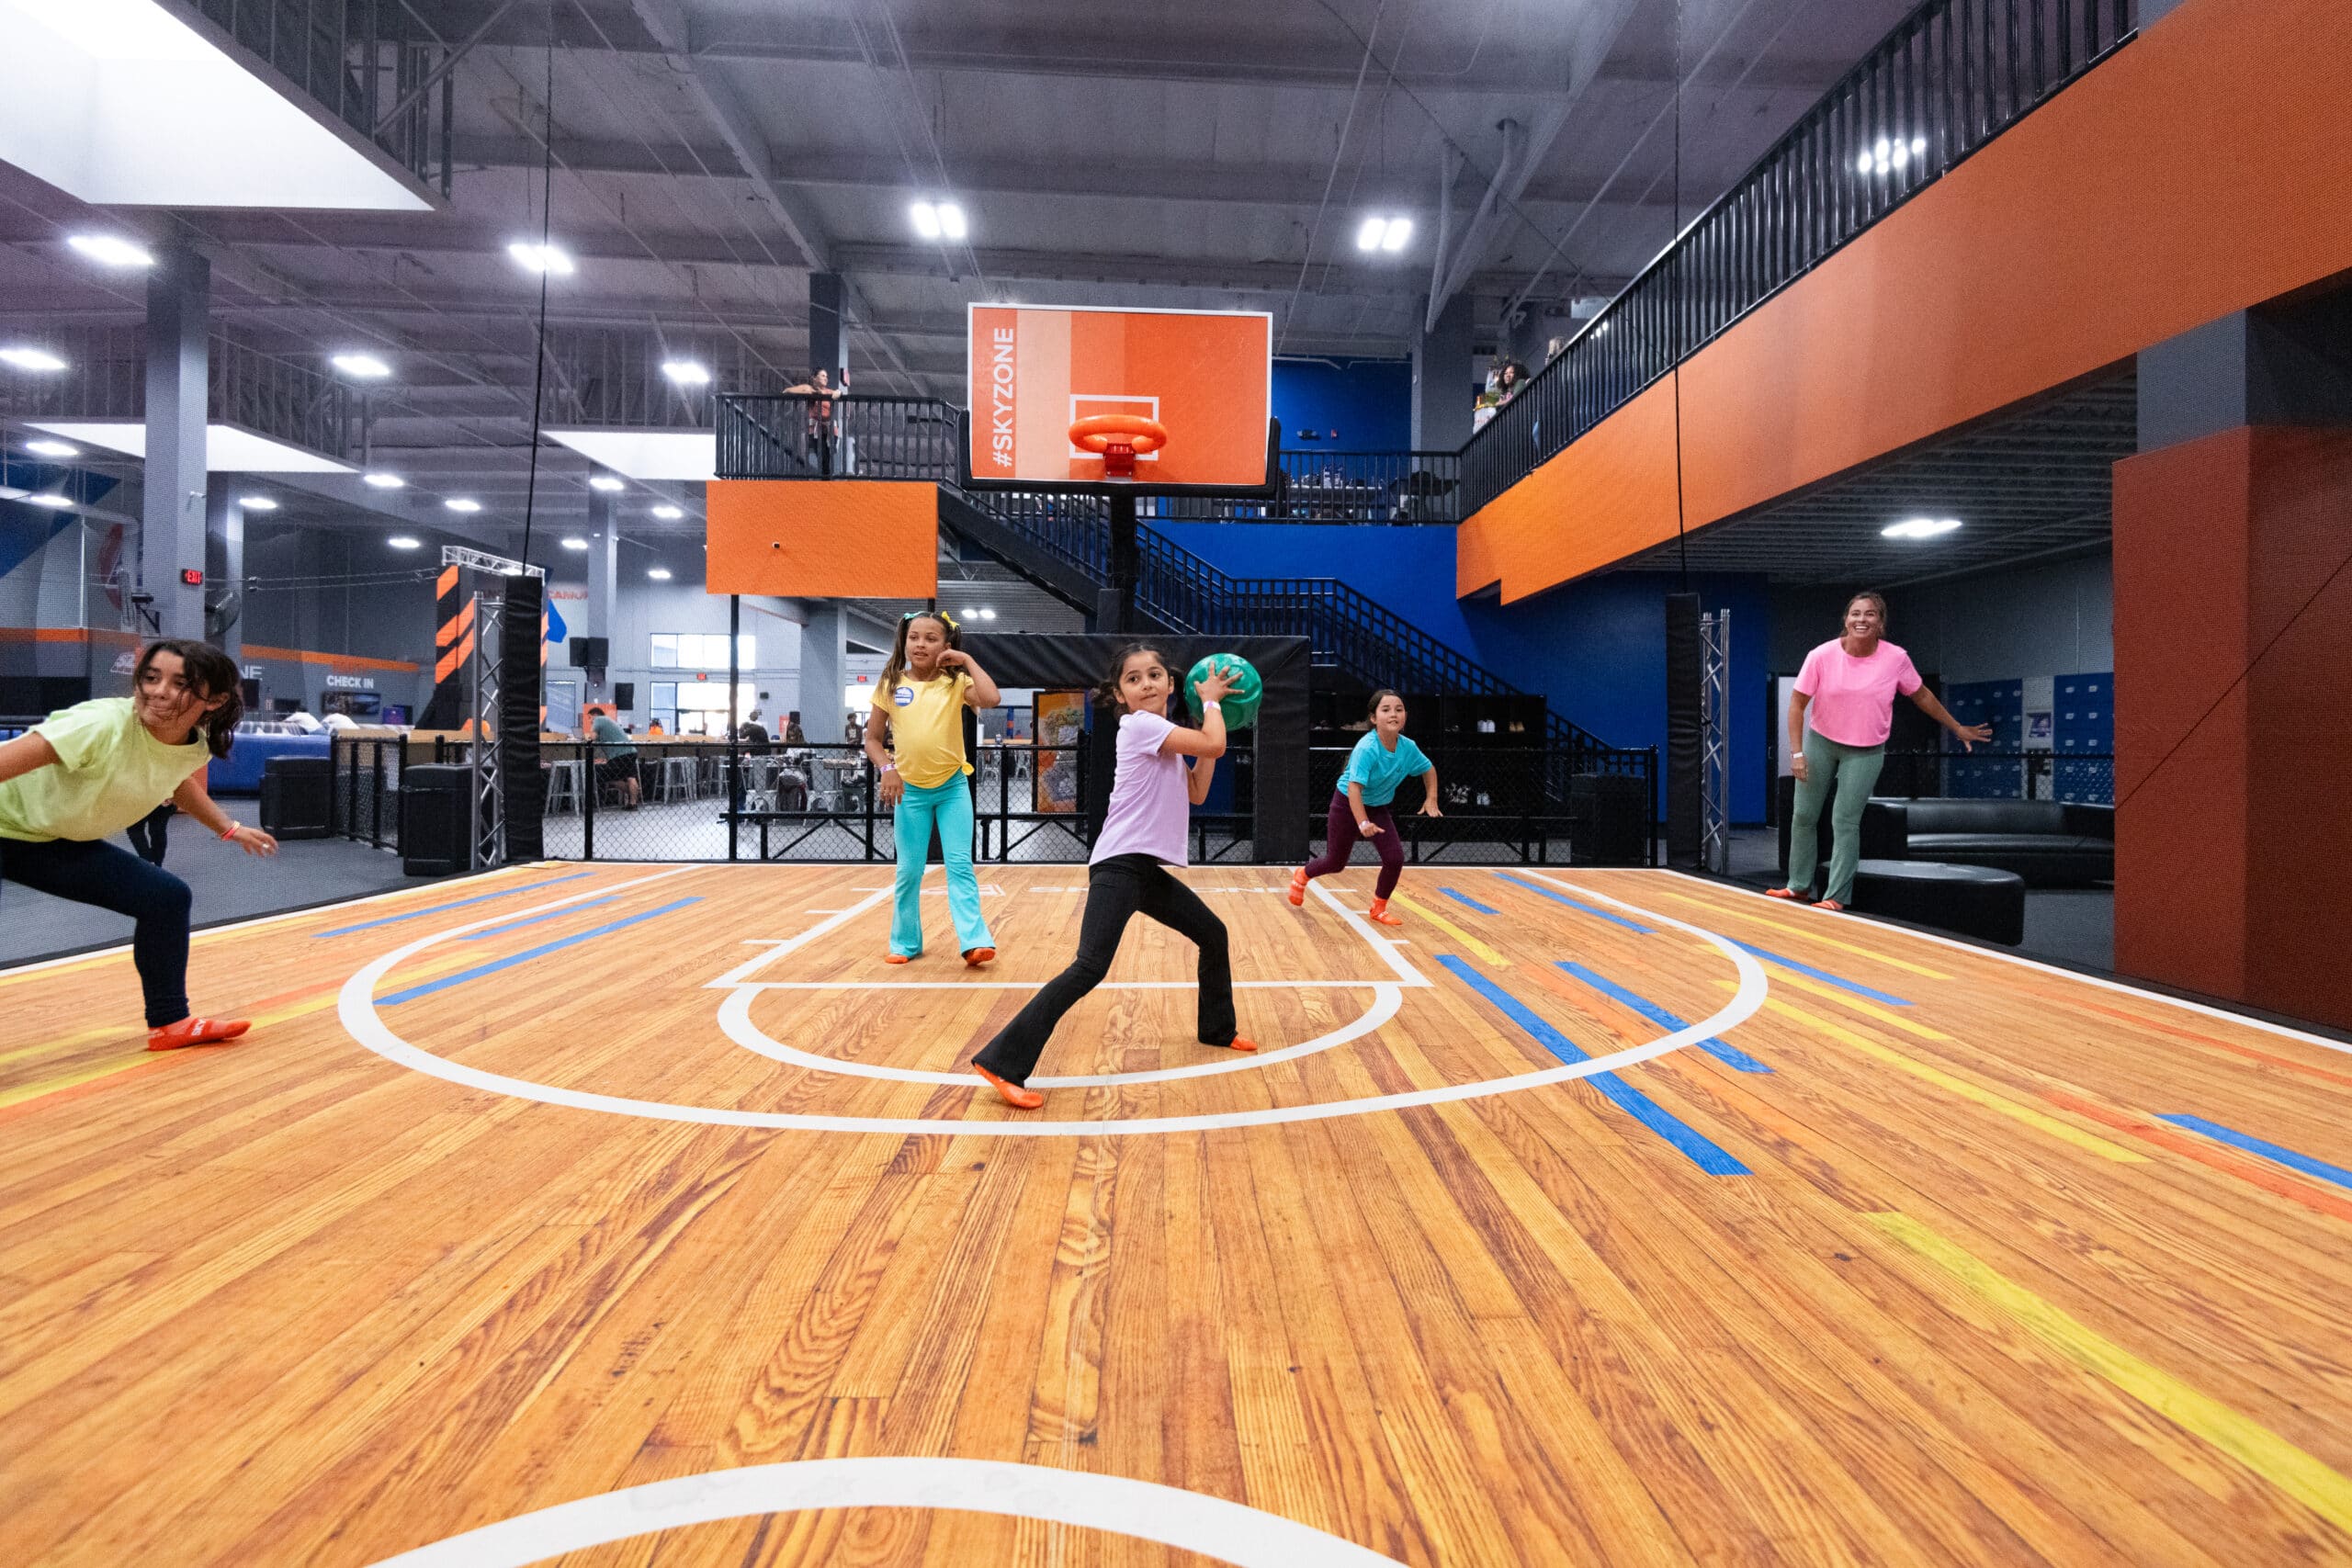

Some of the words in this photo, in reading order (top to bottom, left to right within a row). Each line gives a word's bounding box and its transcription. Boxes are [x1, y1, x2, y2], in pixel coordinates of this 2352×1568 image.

[992, 327, 1014, 468] #SKYZONE
[326, 674, 362, 689] CHECK
[363, 678, 374, 689] IN
